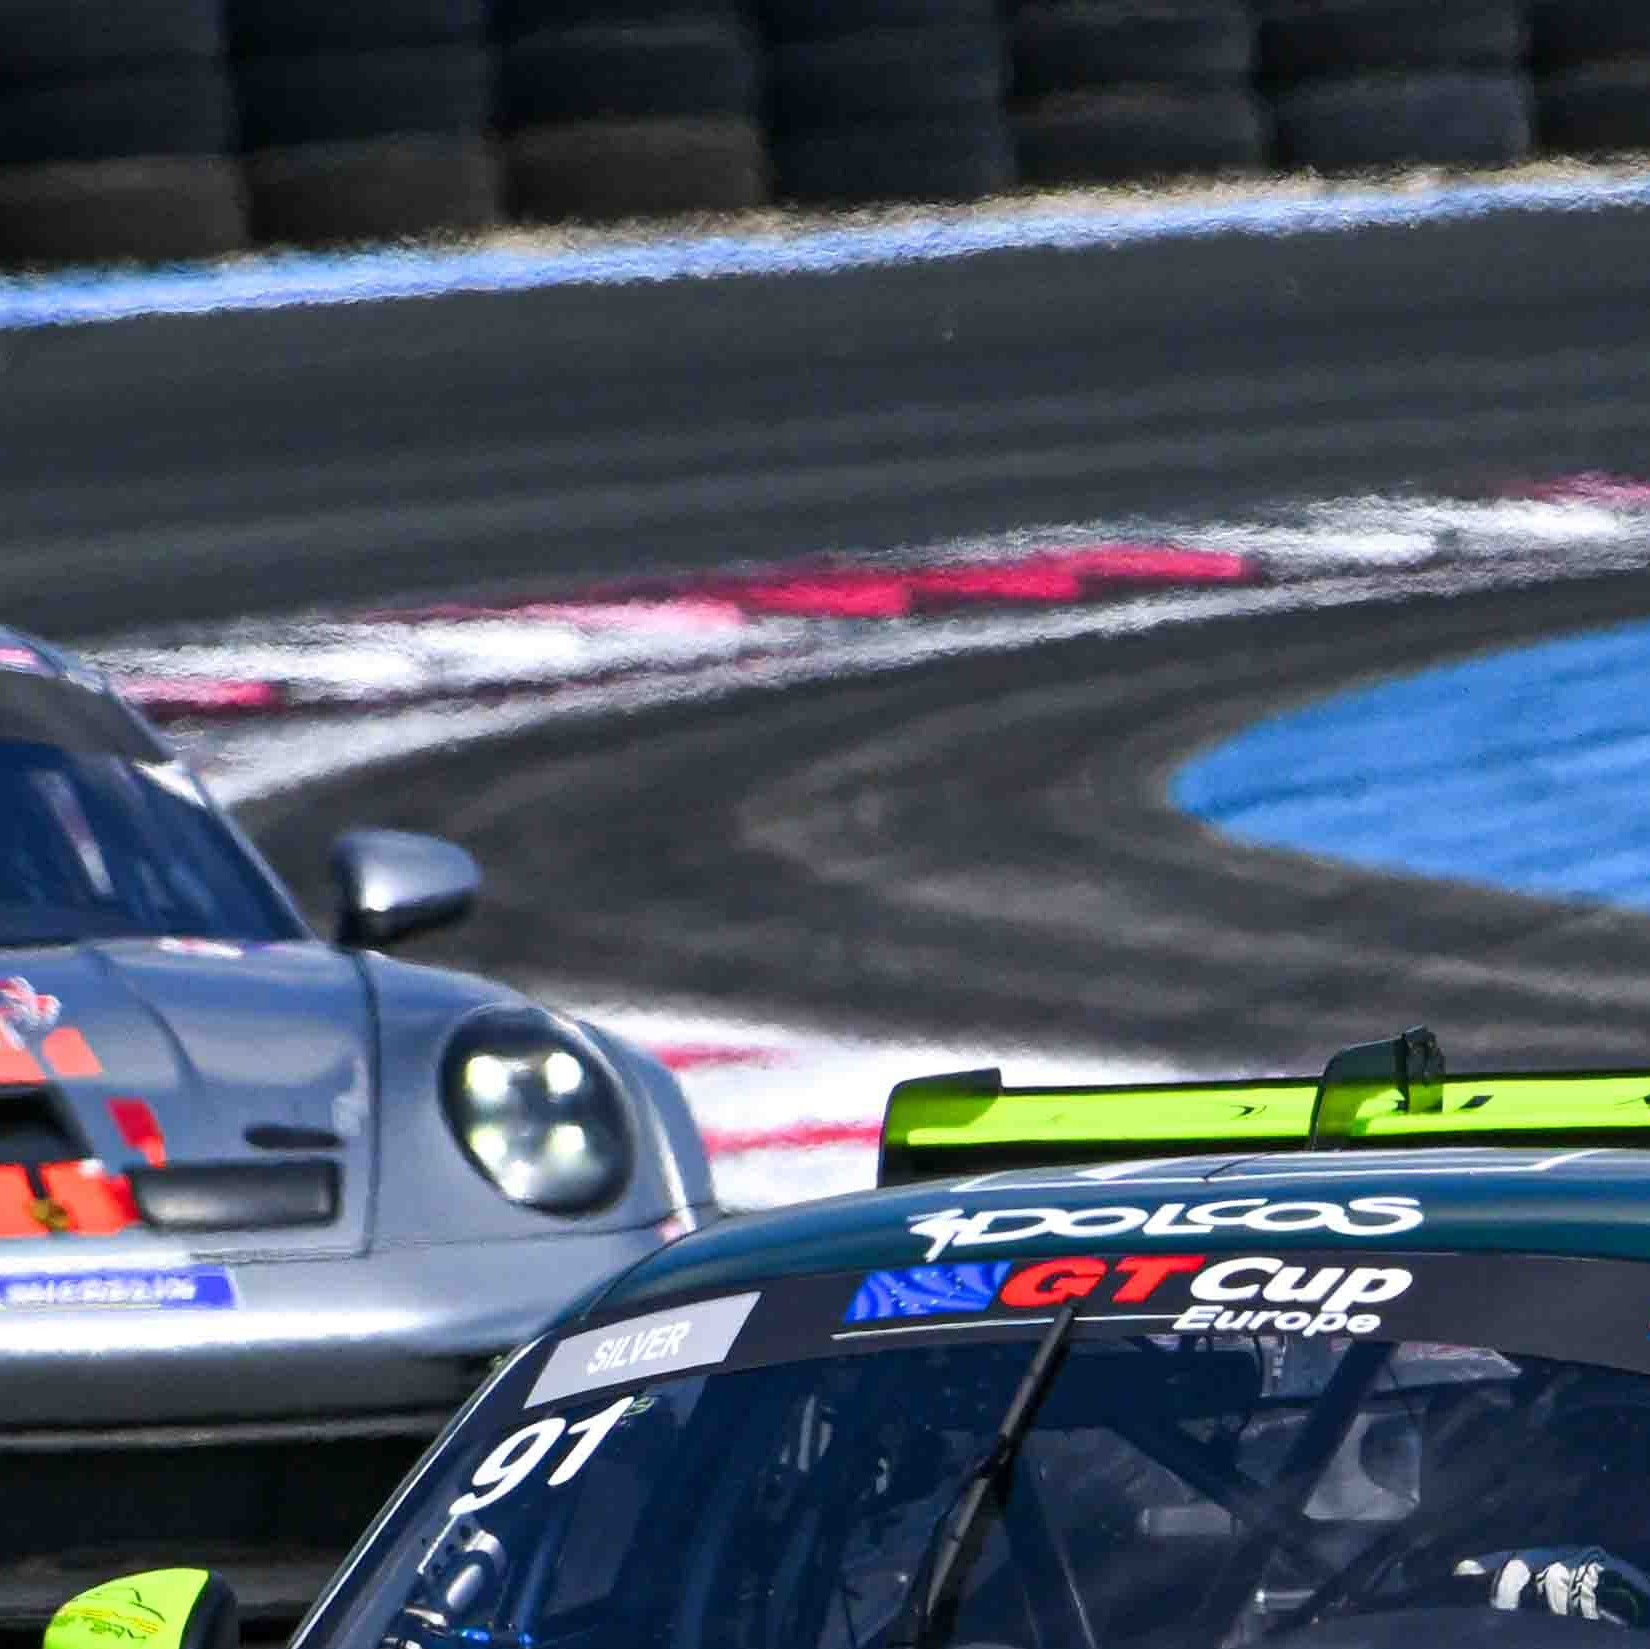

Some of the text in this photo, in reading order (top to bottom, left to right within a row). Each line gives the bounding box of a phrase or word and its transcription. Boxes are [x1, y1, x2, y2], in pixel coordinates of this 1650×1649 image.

[999, 1256, 1412, 1310] GT Cup
[586, 1320, 691, 1375] SILVER
[1172, 1306, 1381, 1336] Europe
[450, 1397, 635, 1515] 91
